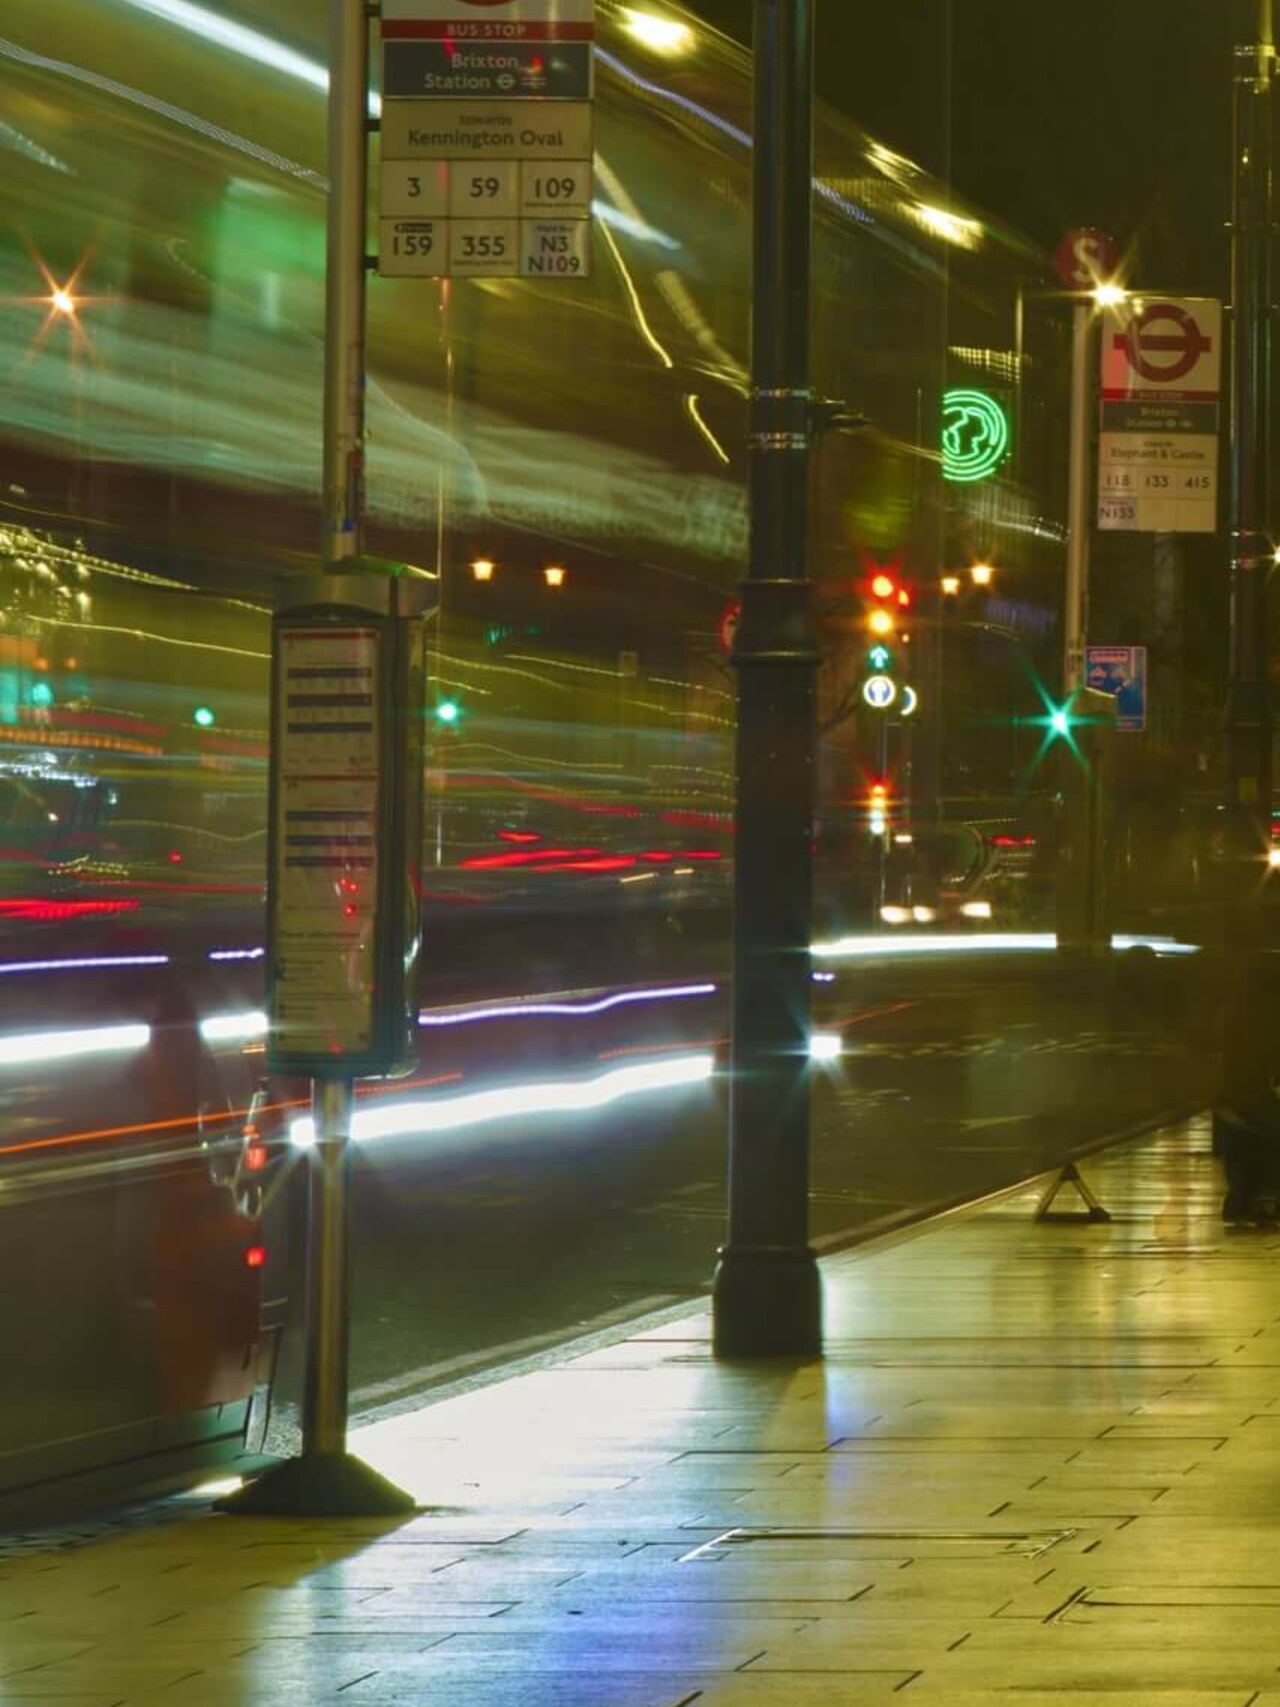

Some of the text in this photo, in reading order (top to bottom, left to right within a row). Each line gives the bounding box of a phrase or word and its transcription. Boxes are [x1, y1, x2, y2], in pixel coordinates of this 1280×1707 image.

[447, 23, 526, 37] BUS STOP
[451, 53, 519, 69] Brixton
[424, 73, 491, 89] Station
[408, 130, 563, 148] Kennington Oval
[407, 177, 421, 197] 3
[470, 177, 499, 198] 59
[534, 178, 575, 198] 109
[393, 236, 432, 256] 159
[461, 236, 505, 256] 355
[540, 237, 568, 253] N3
[528, 256, 580, 273] N109
[1073, 237, 1099, 283] S
[1145, 475, 1169, 488] 133
[1184, 476, 1210, 489] 415
